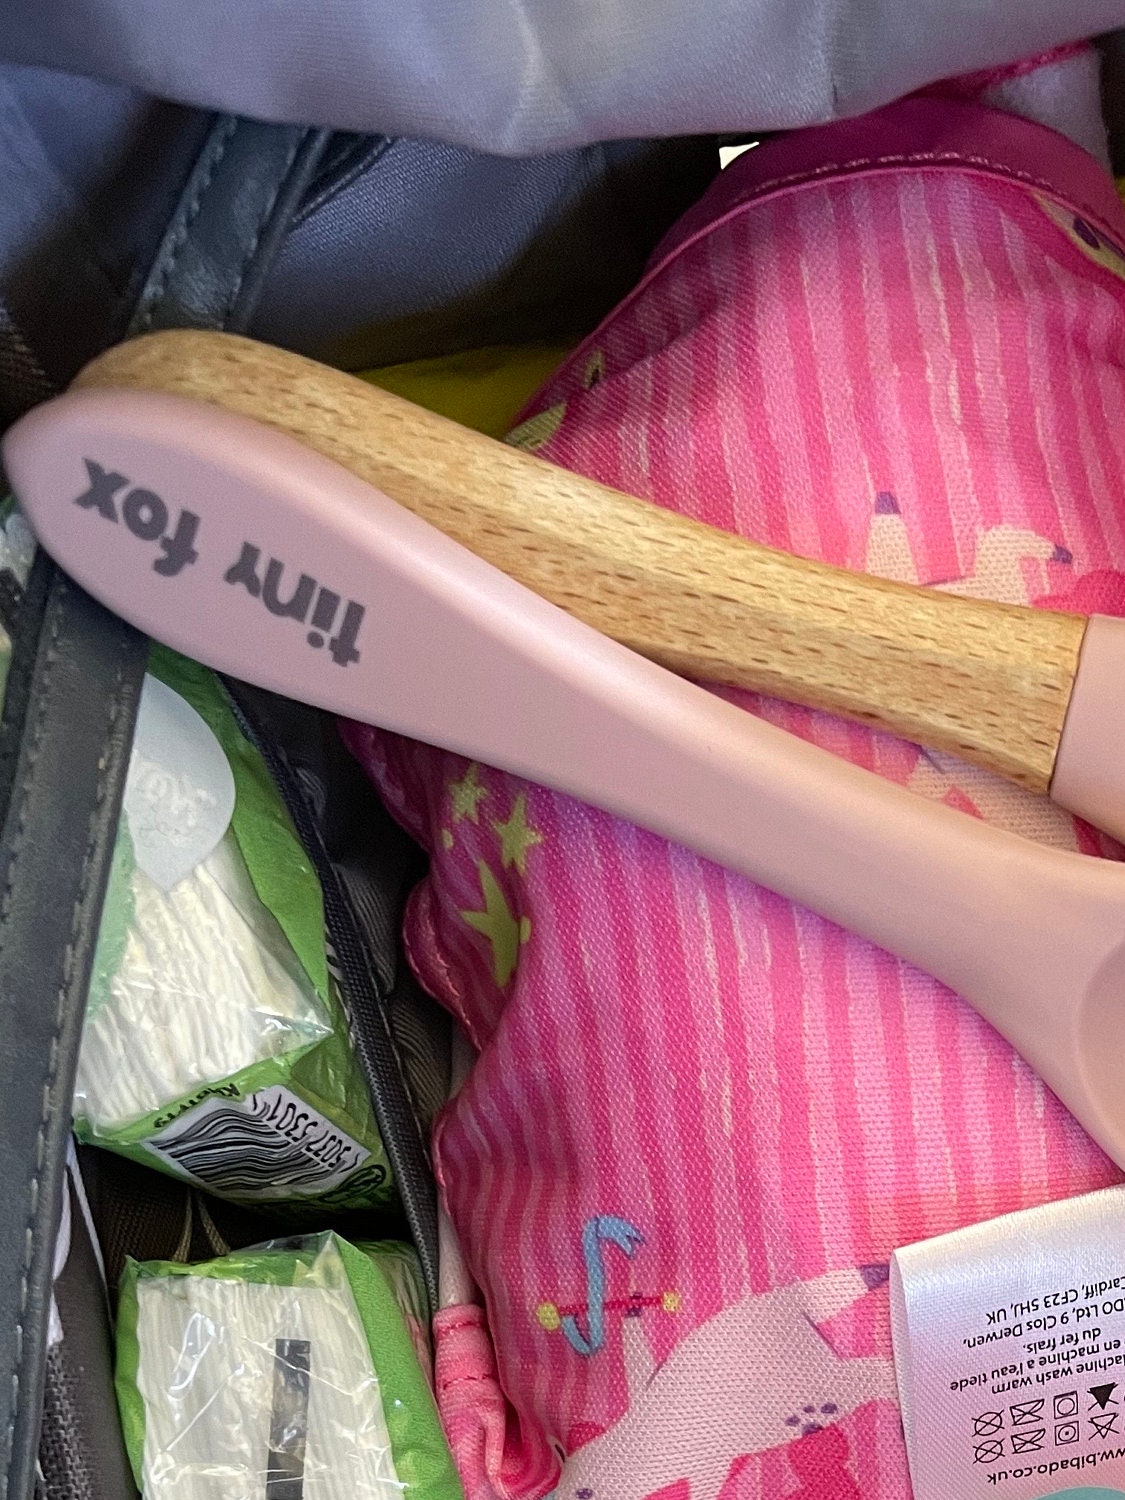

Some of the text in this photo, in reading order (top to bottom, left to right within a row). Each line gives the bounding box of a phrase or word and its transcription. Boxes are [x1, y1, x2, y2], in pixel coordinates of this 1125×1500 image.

[72, 457, 366, 667] tiny fox
[1044, 1289, 1079, 1308] CF23
[1010, 1298, 1039, 1318] 5HJ,
[1072, 1304, 1099, 1322] Ltd,
[986, 1309, 1007, 1325] UK
[1026, 1315, 1057, 1332] Clos
[1060, 1311, 1070, 1324] 9
[963, 1323, 1023, 1349] Derwen,
[1060, 1331, 1080, 1346] fer
[1082, 1327, 1102, 1342] du
[1104, 1339, 1121, 1350] en
[1038, 1343, 1100, 1366] machine
[991, 1365, 1023, 1380] l'eau
[1027, 1360, 1035, 1369] a
[1035, 1366, 1073, 1384] wash
[991, 1375, 1033, 1394] warm
